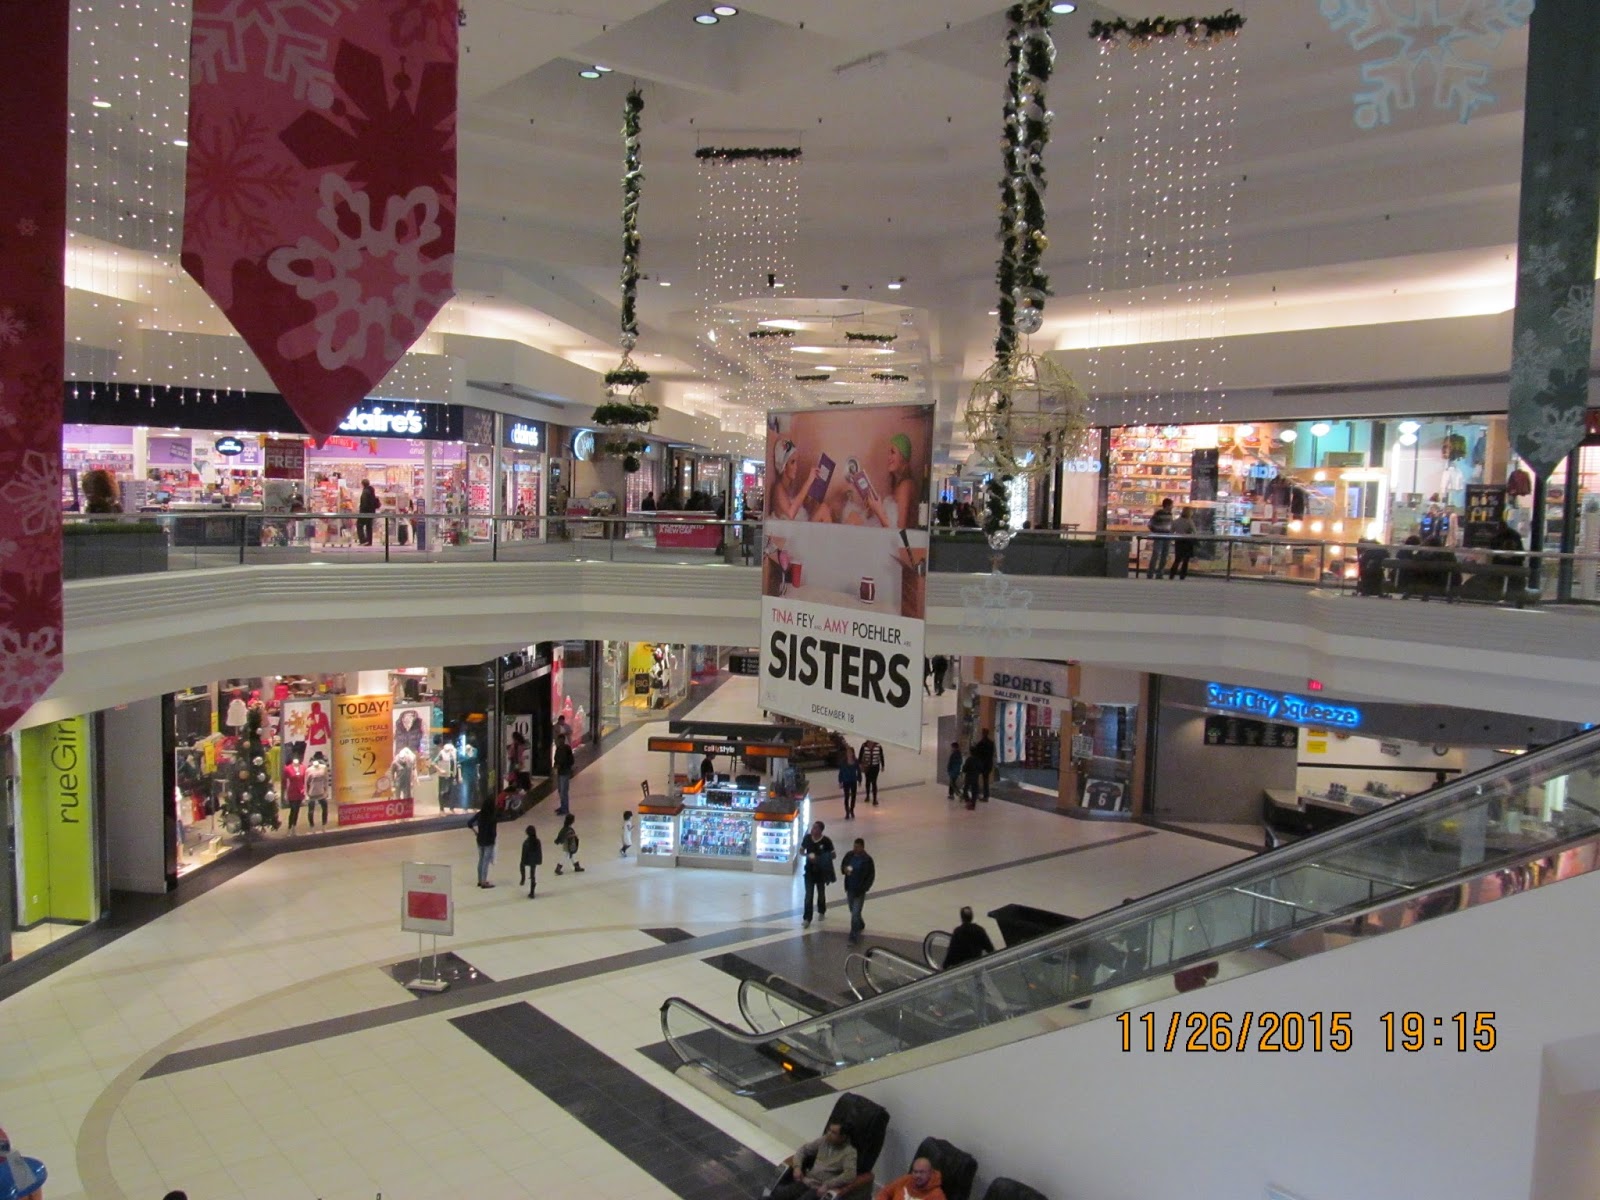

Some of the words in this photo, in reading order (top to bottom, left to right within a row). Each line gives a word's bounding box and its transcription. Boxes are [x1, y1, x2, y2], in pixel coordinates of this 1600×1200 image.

[511, 423, 538, 446] claire's
[266, 455, 303, 469] FREE
[772, 608, 794, 625] TINA
[796, 612, 814, 629] FEY
[823, 618, 849, 636] AMY
[852, 622, 902, 645] POEHLER
[768, 630, 911, 709] SISTERS
[993, 673, 1052, 694] SPORTS
[994, 689, 1021, 699] GALLERY
[1032, 696, 1050, 704] GIFTS
[1207, 684, 1242, 706] Surf
[1246, 690, 1278, 716] City
[1280, 695, 1358, 726] Squeeze
[337, 701, 390, 715] TODAY!
[811, 704, 846, 721] DECEMBER
[847, 713, 855, 723] 18
[51, 717, 79, 824] rueGirl
[1098, 792, 1108, 806] 6
[339, 804, 384, 816] EVERYTHING
[351, 812, 371, 820] SALE
